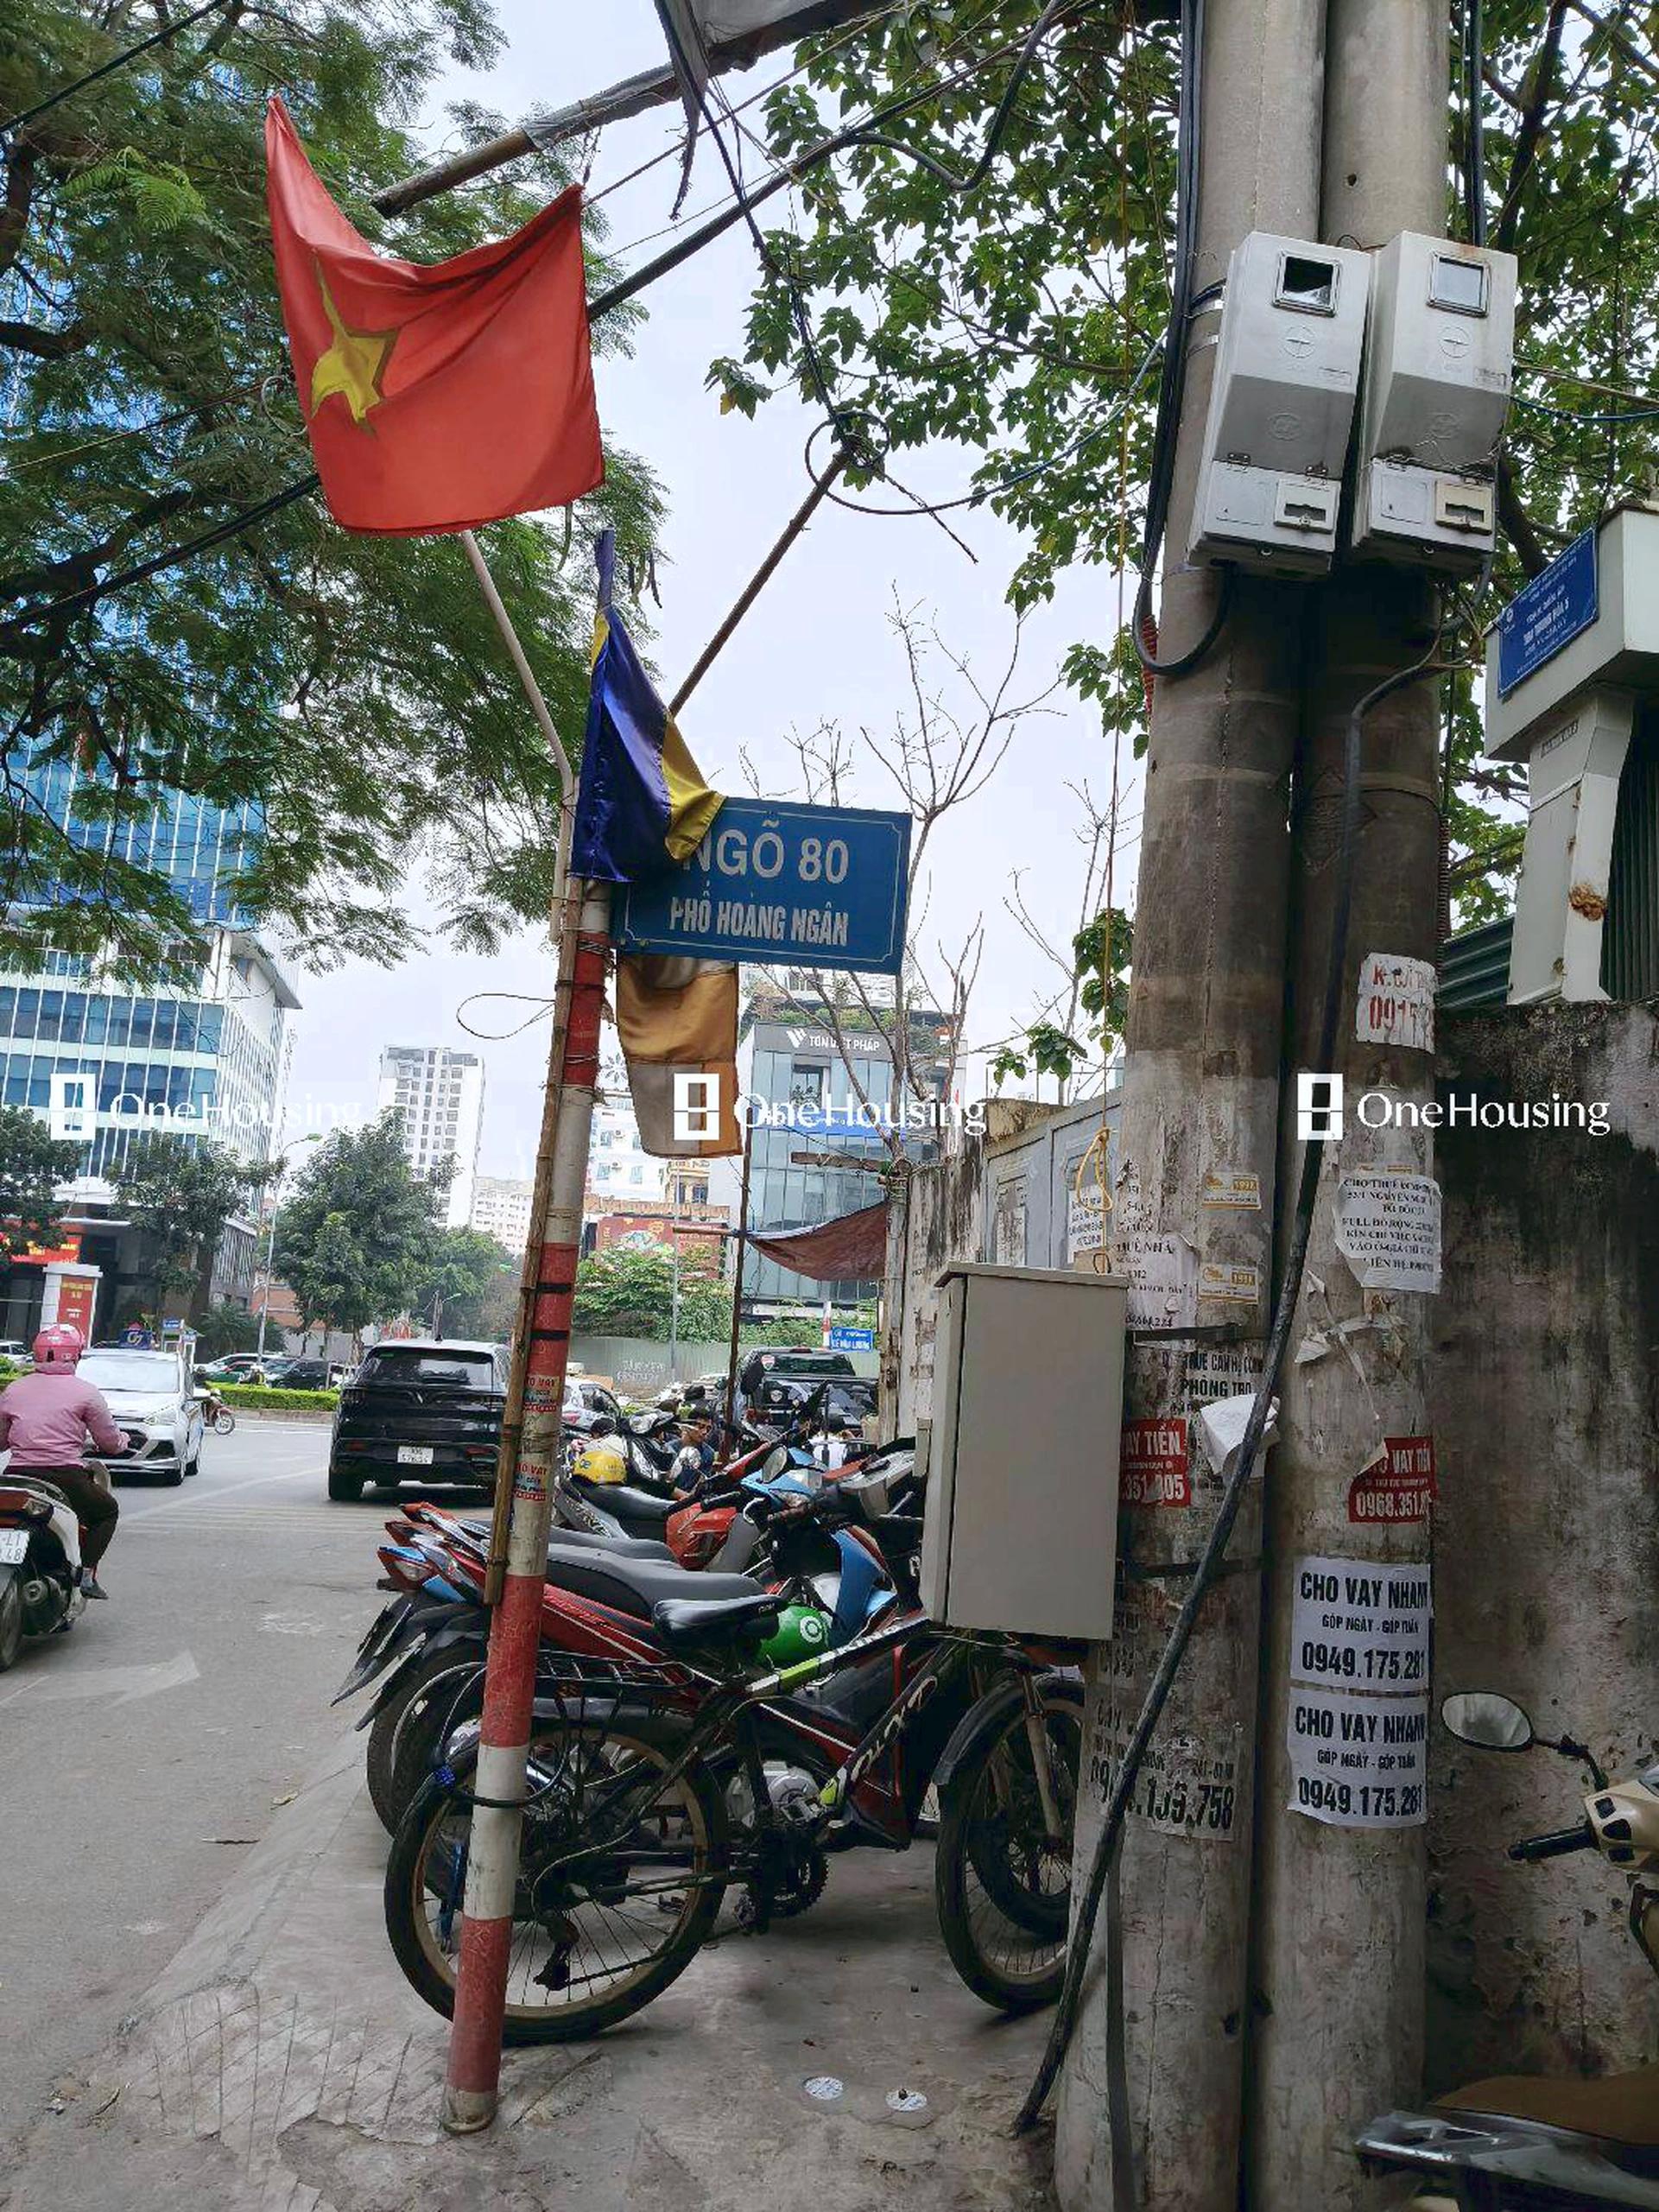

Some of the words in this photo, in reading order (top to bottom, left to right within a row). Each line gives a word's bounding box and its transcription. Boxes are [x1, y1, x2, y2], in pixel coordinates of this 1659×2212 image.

[797, 837, 849, 884] 80
[669, 879, 710, 935] PHỐ
[790, 901, 849, 947] NGÂN
[1301, 1572, 1339, 1603] CHO
[1345, 1577, 1383, 1607] VAY
[1346, 1616, 1374, 1633] NGÀY
[1295, 1706, 1334, 1738] CHO
[1340, 1712, 1377, 1742] VAY
[1298, 1777, 1423, 1816] 0949.175.281
